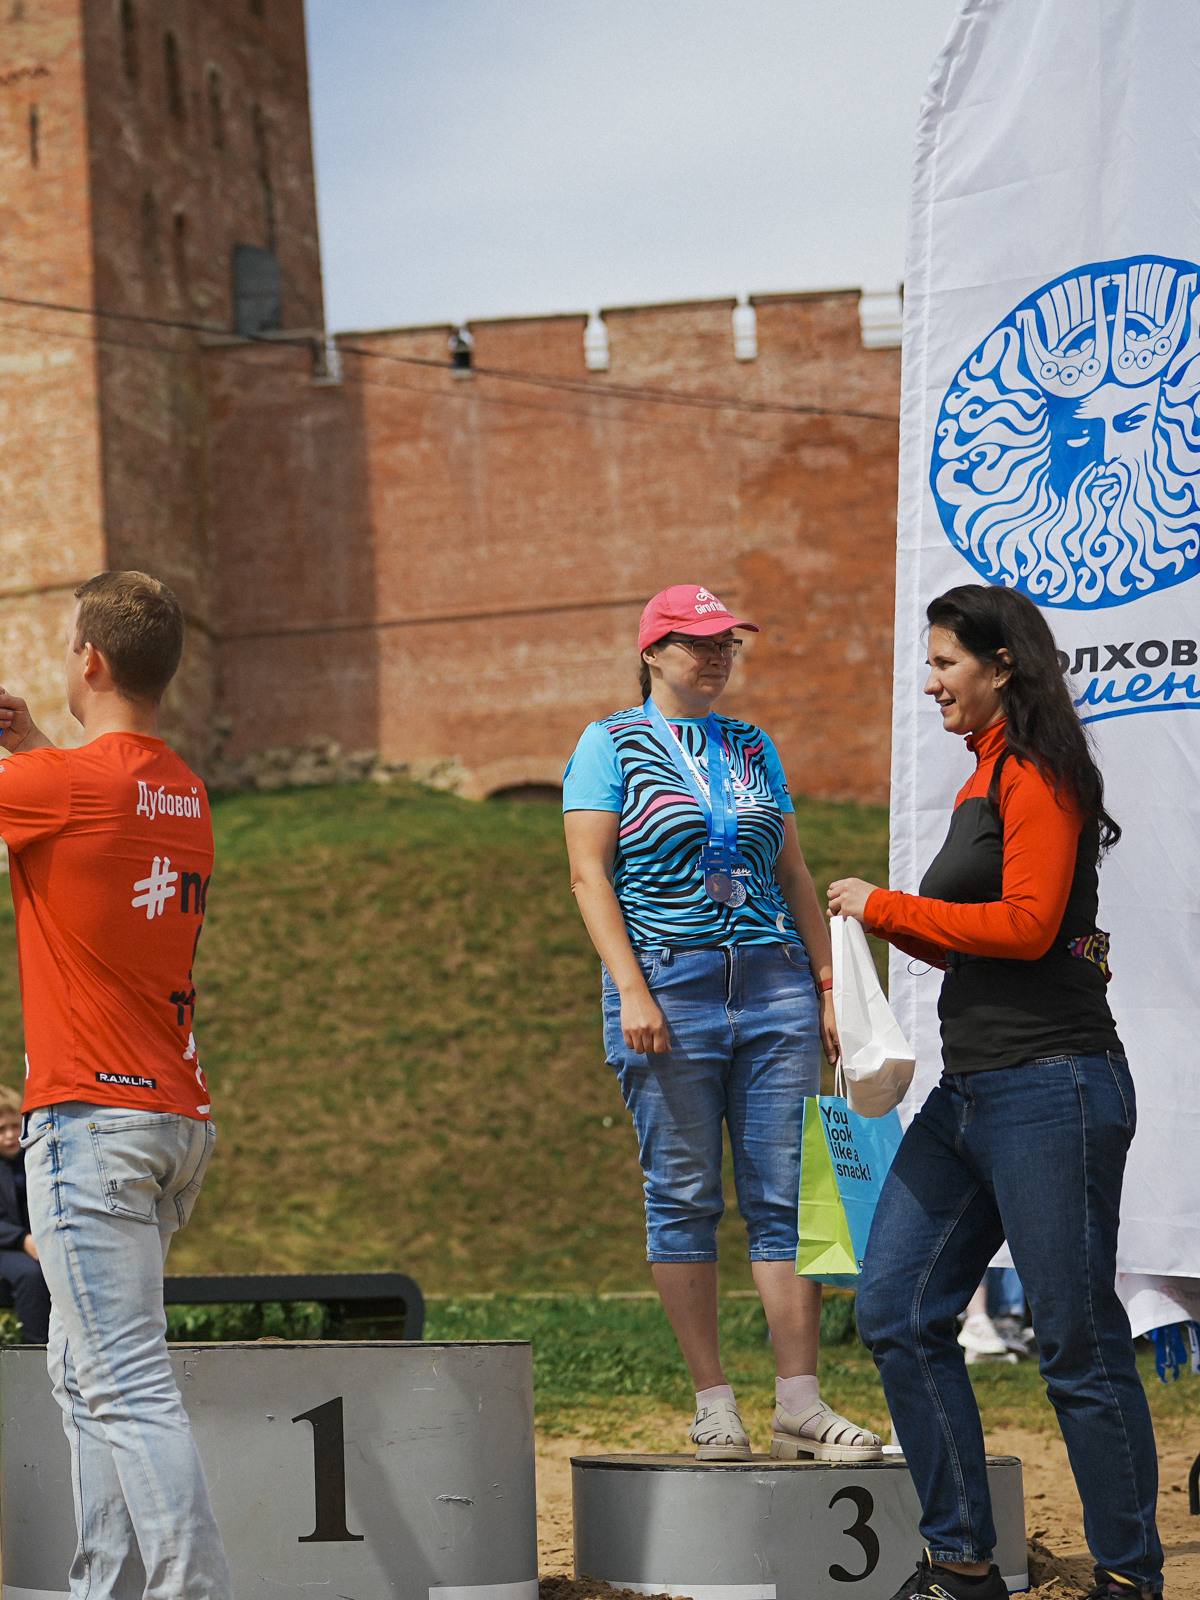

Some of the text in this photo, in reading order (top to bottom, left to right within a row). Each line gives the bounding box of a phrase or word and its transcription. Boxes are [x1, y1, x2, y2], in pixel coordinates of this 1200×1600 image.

[1074, 672, 1200, 707] мен
[136, 780, 201, 820] Дубовой
[820, 1106, 849, 1125] You
[826, 1123, 854, 1143] look
[830, 1141, 860, 1162] like a
[837, 1163, 872, 1181] snack!
[291, 1397, 364, 1542] 1
[828, 1486, 881, 1583] 3
